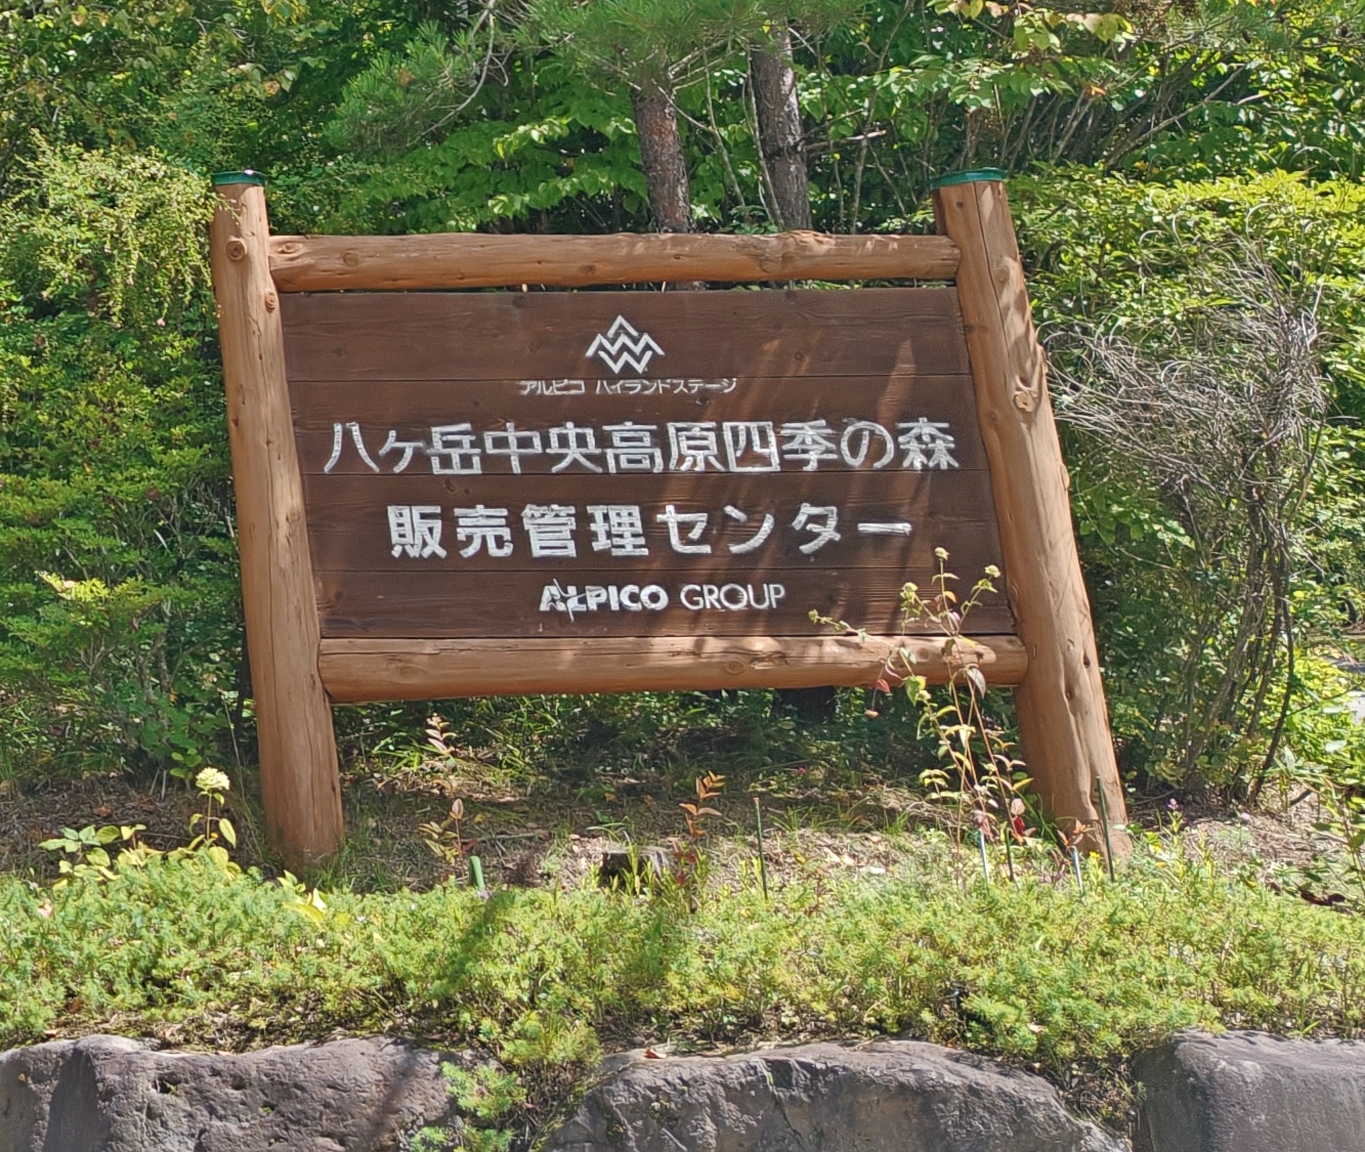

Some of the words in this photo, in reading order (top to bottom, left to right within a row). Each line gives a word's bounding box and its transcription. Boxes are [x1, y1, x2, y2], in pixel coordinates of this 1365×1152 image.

[519, 379, 586, 395] アルピコ
[595, 377, 738, 395] ハイランドステージ
[386, 503, 913, 558] 販売管理センター
[538, 582, 670, 615] ALPICO
[679, 583, 786, 611] GROUP
